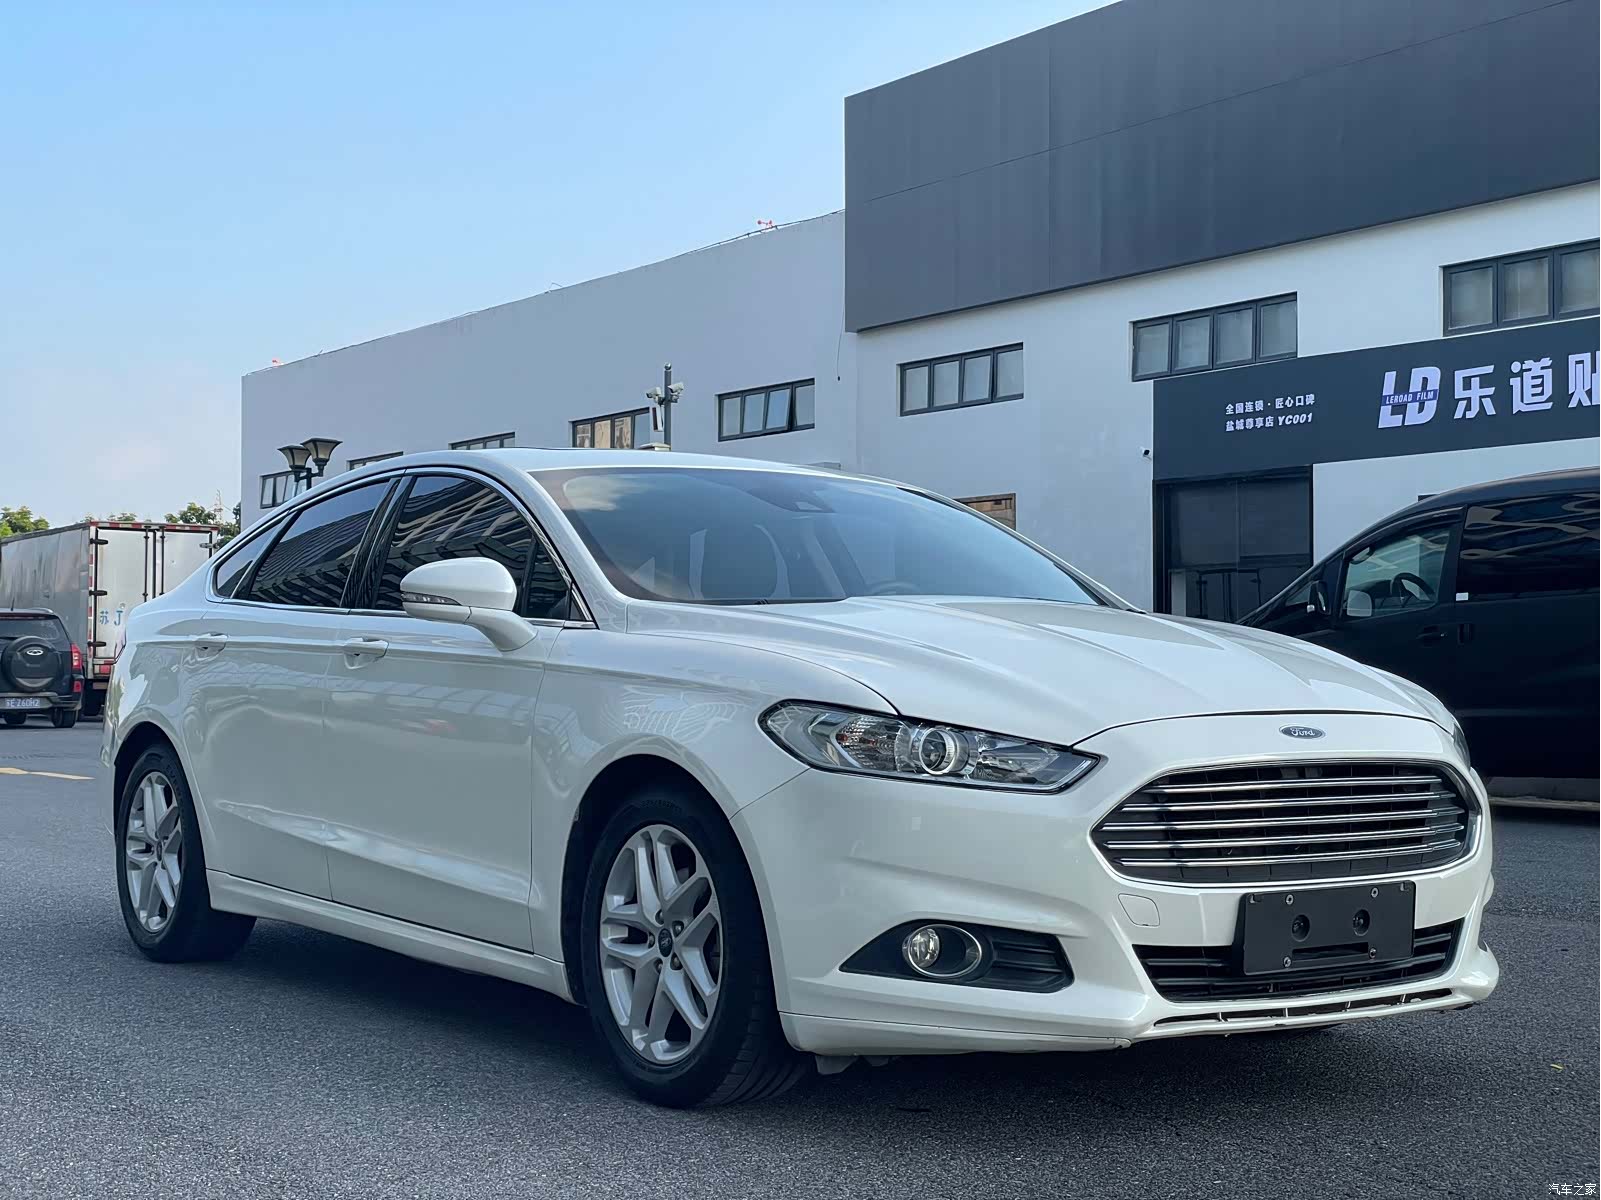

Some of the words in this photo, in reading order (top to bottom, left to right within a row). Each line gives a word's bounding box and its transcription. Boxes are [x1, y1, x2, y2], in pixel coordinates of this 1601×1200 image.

[1378, 366, 1441, 429] LD
[1386, 393, 1413, 405] LEROAD
[1416, 390, 1434, 401] FILM
[1225, 415, 1274, 432] 盐城尊享店
[1278, 412, 1313, 426] YC001
[1290, 727, 1316, 736] Ford
